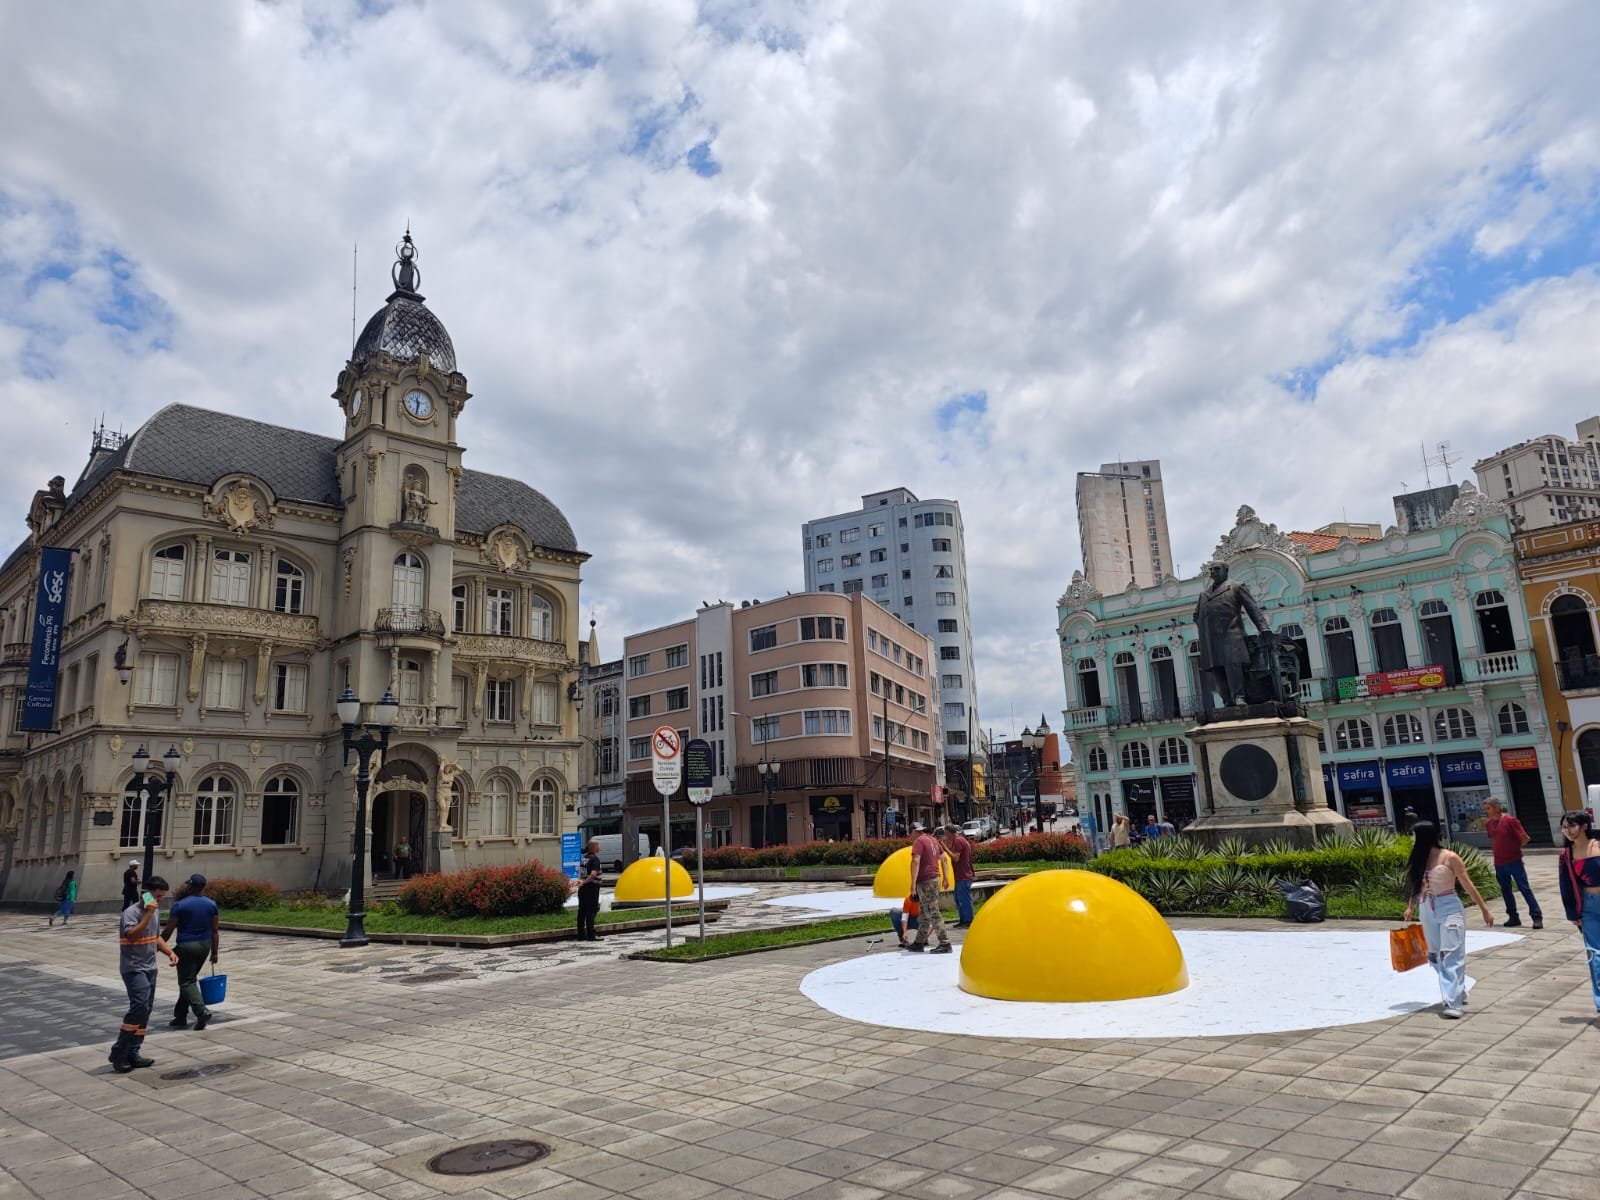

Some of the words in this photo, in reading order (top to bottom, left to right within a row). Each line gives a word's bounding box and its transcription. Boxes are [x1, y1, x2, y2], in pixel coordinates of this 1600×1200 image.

[47, 570, 65, 603] Sesc
[1410, 667, 1442, 676] COMPLETO
[1392, 765, 1425, 776] safira
[1446, 760, 1482, 772] safira
[1343, 769, 1375, 781] safira
